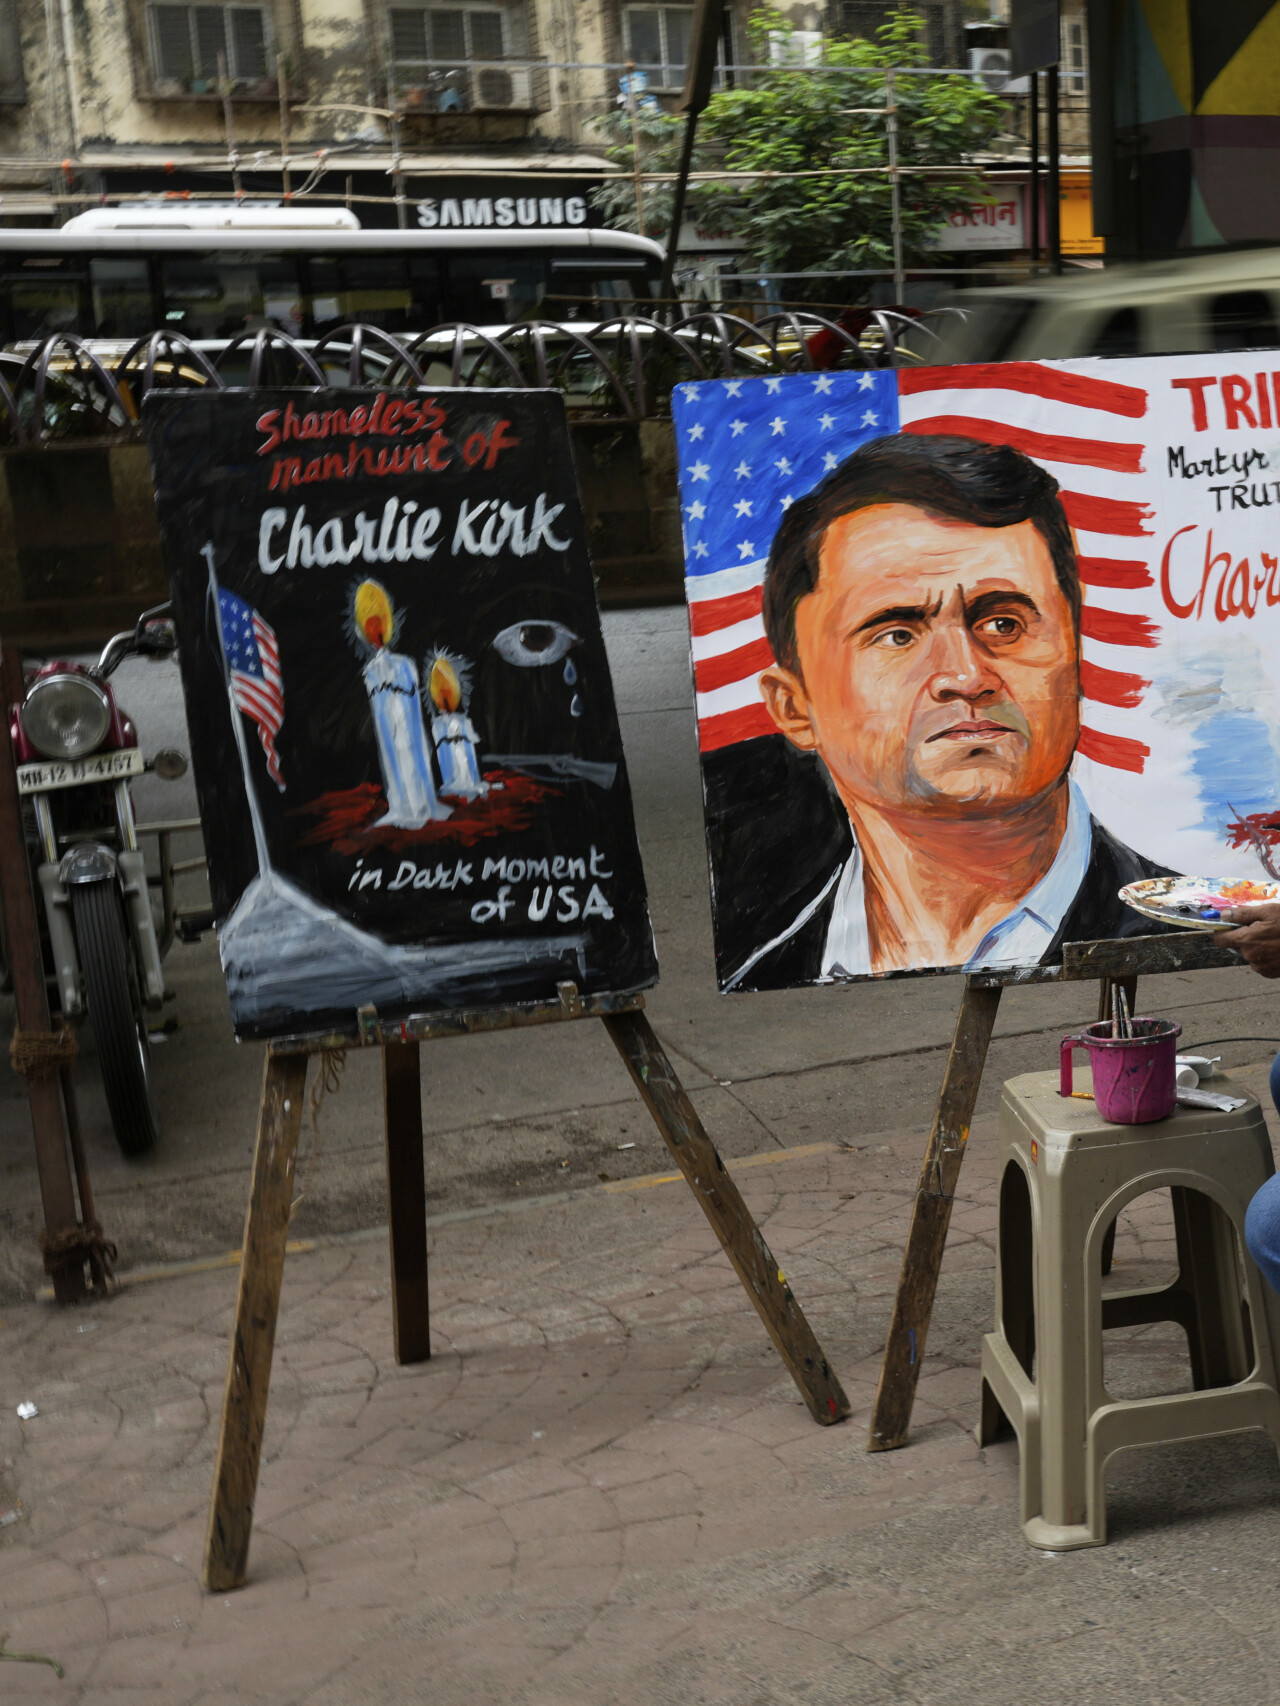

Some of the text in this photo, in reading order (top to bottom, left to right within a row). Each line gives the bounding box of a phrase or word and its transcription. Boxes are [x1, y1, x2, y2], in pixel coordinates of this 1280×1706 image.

[417, 197, 587, 227] SAMSUNG
[256, 391, 447, 456] Shameless
[268, 419, 521, 492] manhunt of
[1167, 445, 1270, 483] Martyr
[258, 493, 572, 574] Charlie Kirk
[348, 858, 382, 891] in
[387, 858, 473, 891] Dark
[470, 883, 614, 923] of USA
